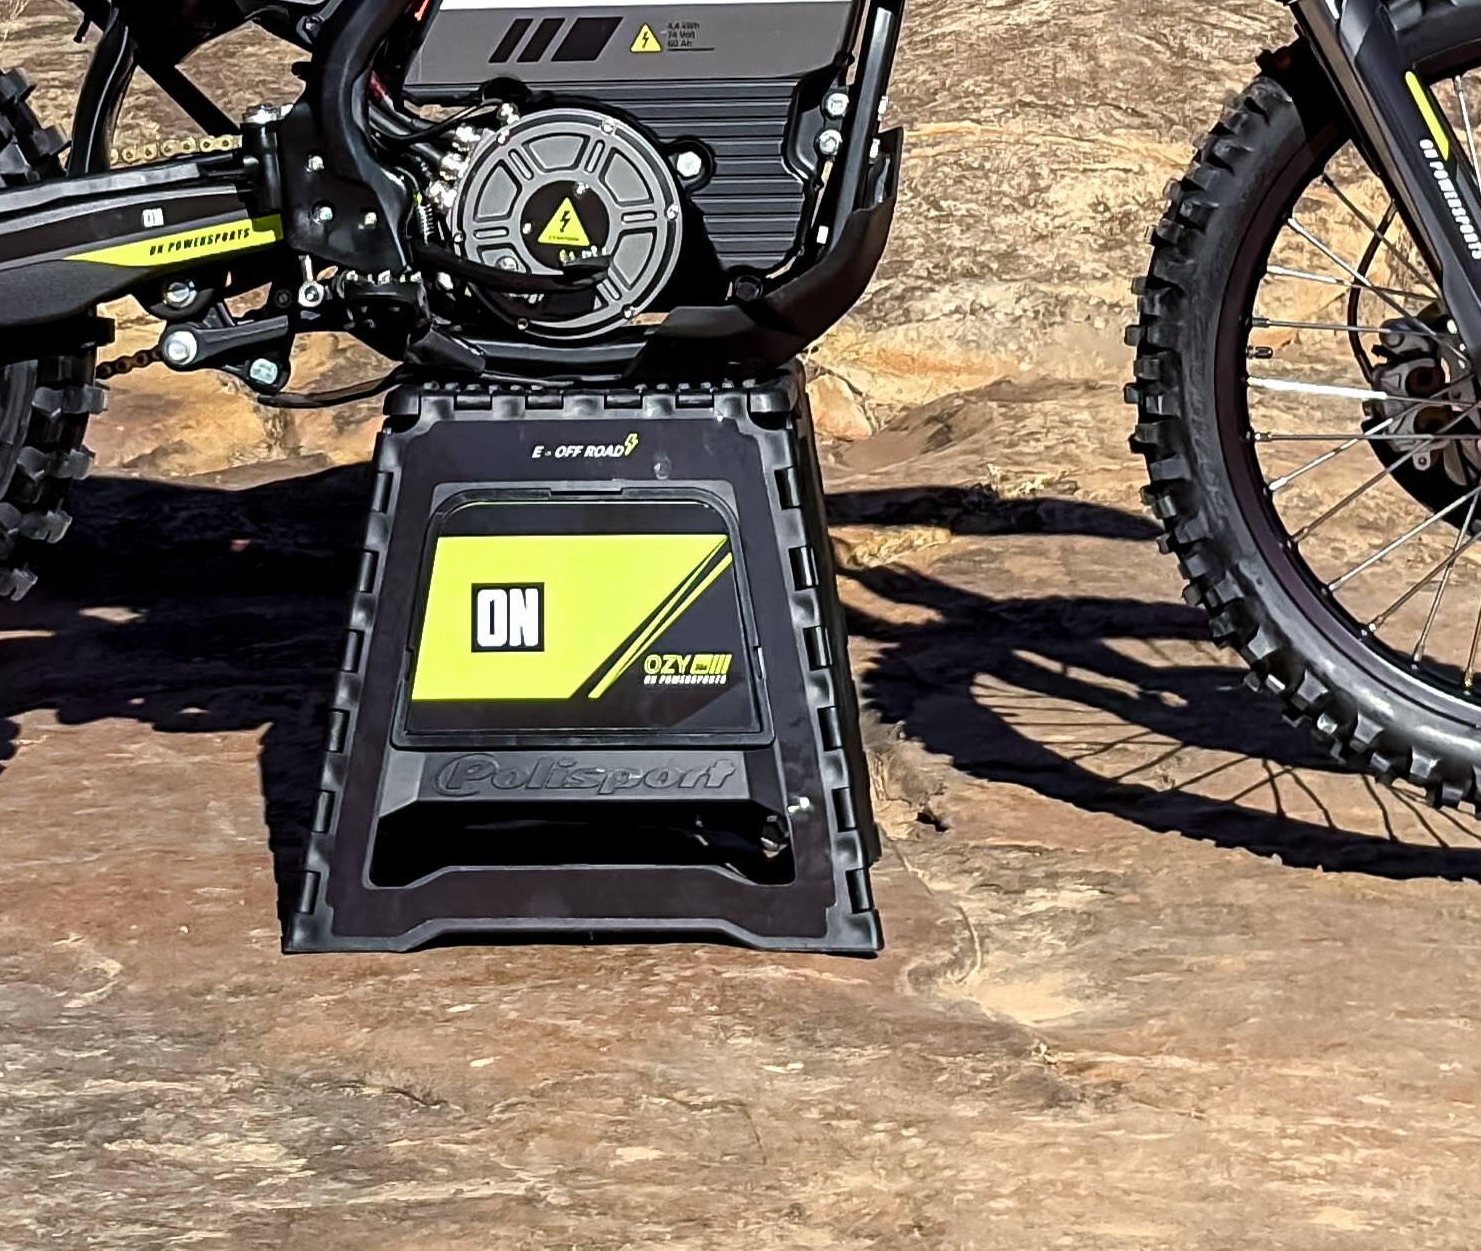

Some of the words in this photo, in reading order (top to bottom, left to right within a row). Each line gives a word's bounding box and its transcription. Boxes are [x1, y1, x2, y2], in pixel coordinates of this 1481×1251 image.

[168, 228, 251, 253] POWERSPORTS
[531, 445, 544, 459] E
[554, 445, 584, 459] OFF
[584, 444, 625, 458] ROAD
[477, 588, 539, 647] ON
[644, 654, 692, 675] OZY
[433, 753, 736, 796] Polisport
